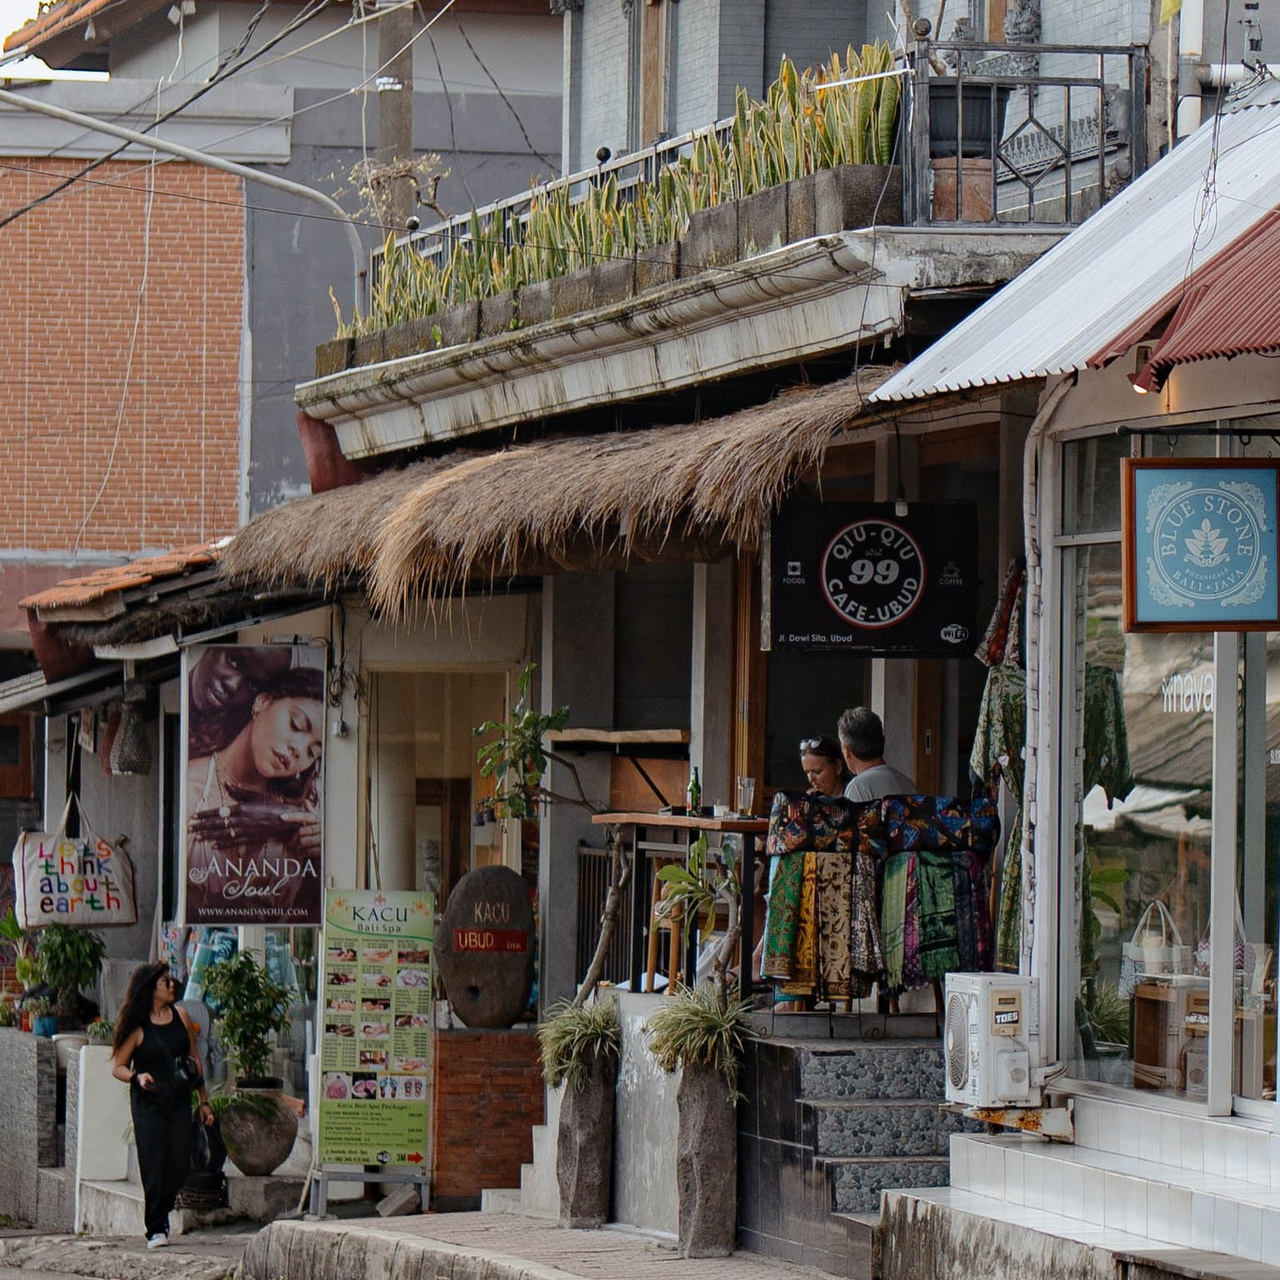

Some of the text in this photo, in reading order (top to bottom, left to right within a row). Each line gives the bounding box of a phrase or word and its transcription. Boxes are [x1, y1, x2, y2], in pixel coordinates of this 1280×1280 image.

[1161, 495, 1253, 557] BLUE STONE
[832, 526, 915, 561] QIU-QIU
[783, 577, 805, 585] FOODS
[848, 559, 900, 585] 99
[938, 578, 963, 586] COFFEE
[1172, 569, 1245, 593] BALI JAVA
[828, 577, 919, 621] CAFE-UBUD
[830, 634, 853, 642] Ubud
[189, 855, 318, 883] ANANDA
[40, 874, 119, 894] about
[223, 872, 290, 899] Soul
[40, 892, 121, 913] earth
[198, 907, 309, 917] WWW.ANANDASOUL.COM
[474, 900, 511, 924] KACU
[352, 906, 408, 923] KACU
[357, 923, 402, 934] Bali Spa
[458, 932, 495, 949] UBUD
